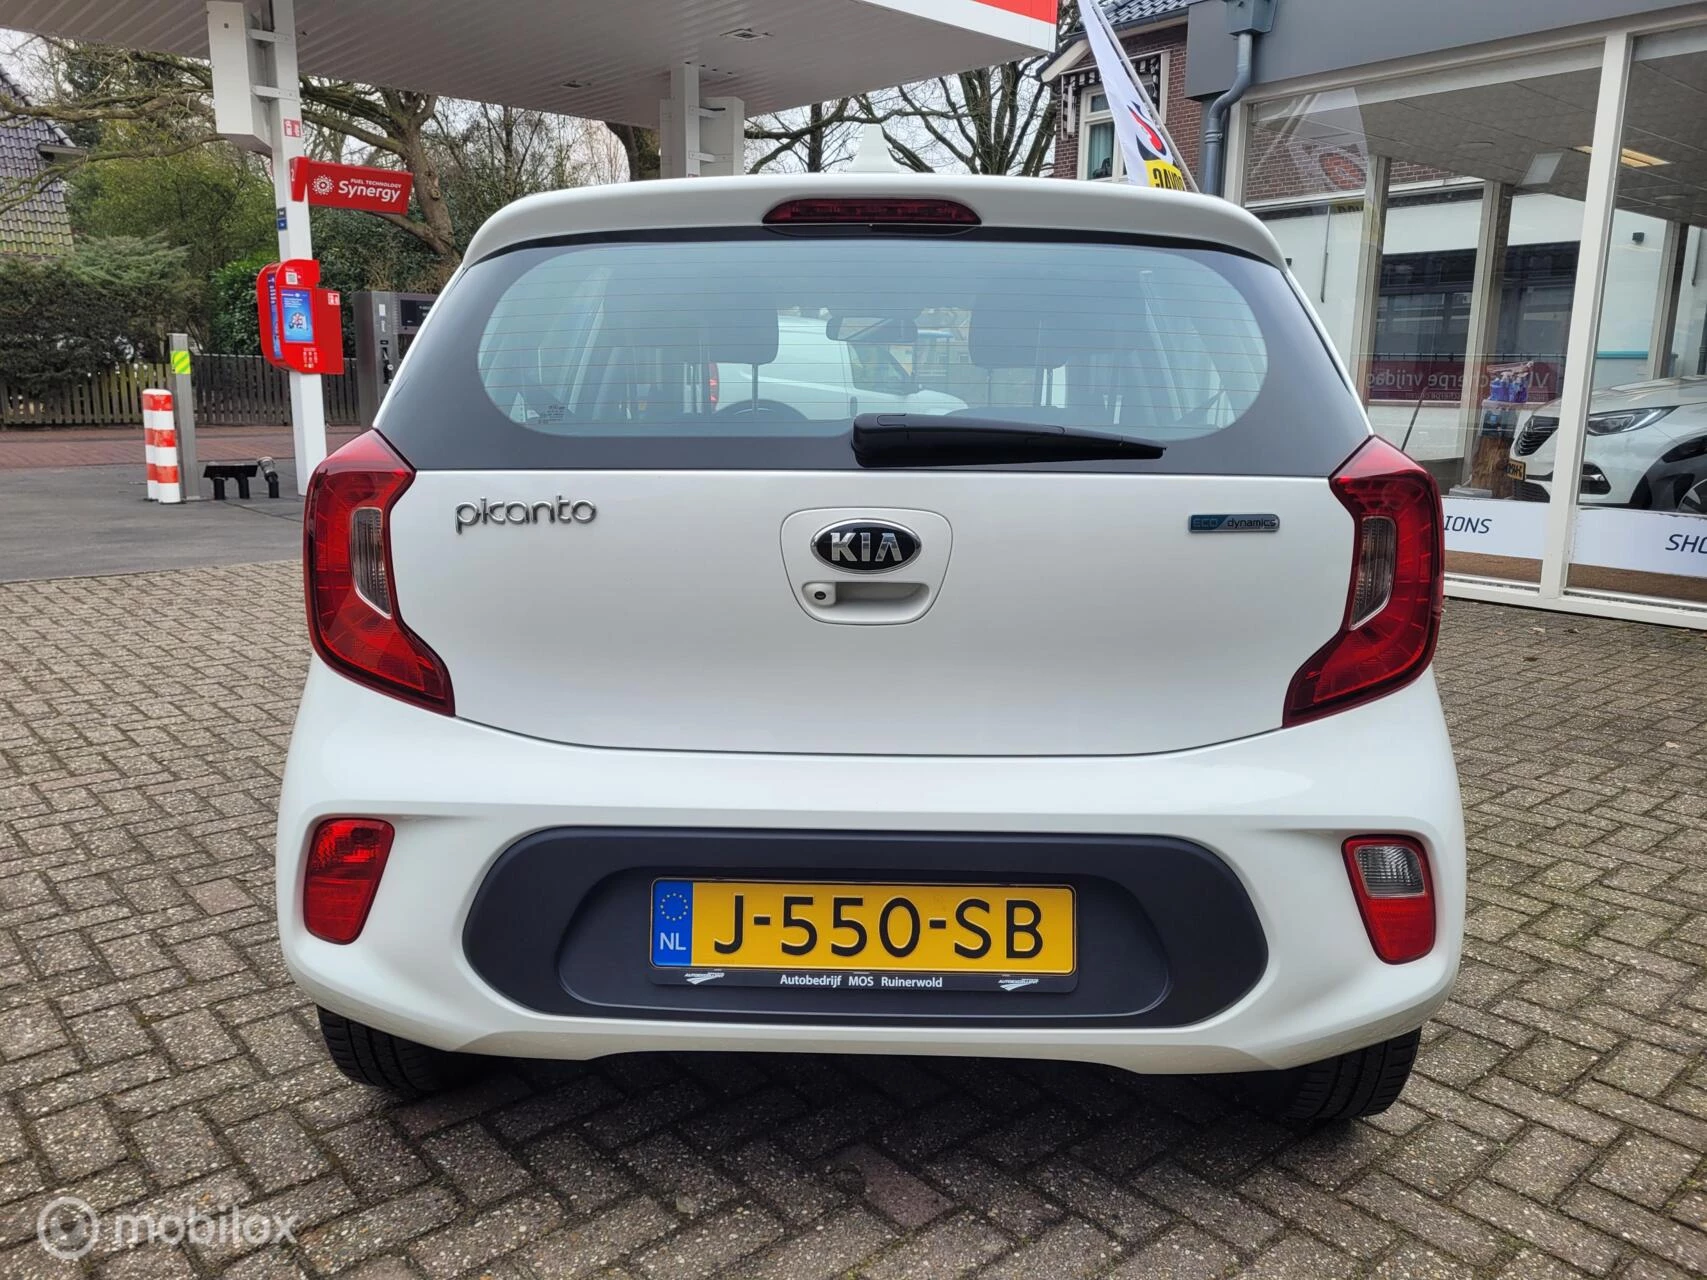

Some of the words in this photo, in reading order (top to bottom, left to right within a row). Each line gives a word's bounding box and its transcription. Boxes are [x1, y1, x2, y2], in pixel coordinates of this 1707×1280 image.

[338, 180, 401, 203] Synergy
[350, 177, 365, 185] FUEL
[366, 179, 402, 189] TECHNOLOGY
[456, 495, 597, 535] picanto
[1227, 517, 1277, 529] dynamics
[830, 532, 903, 562] KIA
[713, 894, 1045, 960] J-550-SB
[659, 932, 687, 951] NL
[780, 974, 842, 989] Autobedrijf
[848, 975, 874, 987] MOS
[881, 976, 943, 989] Ruinerwold
